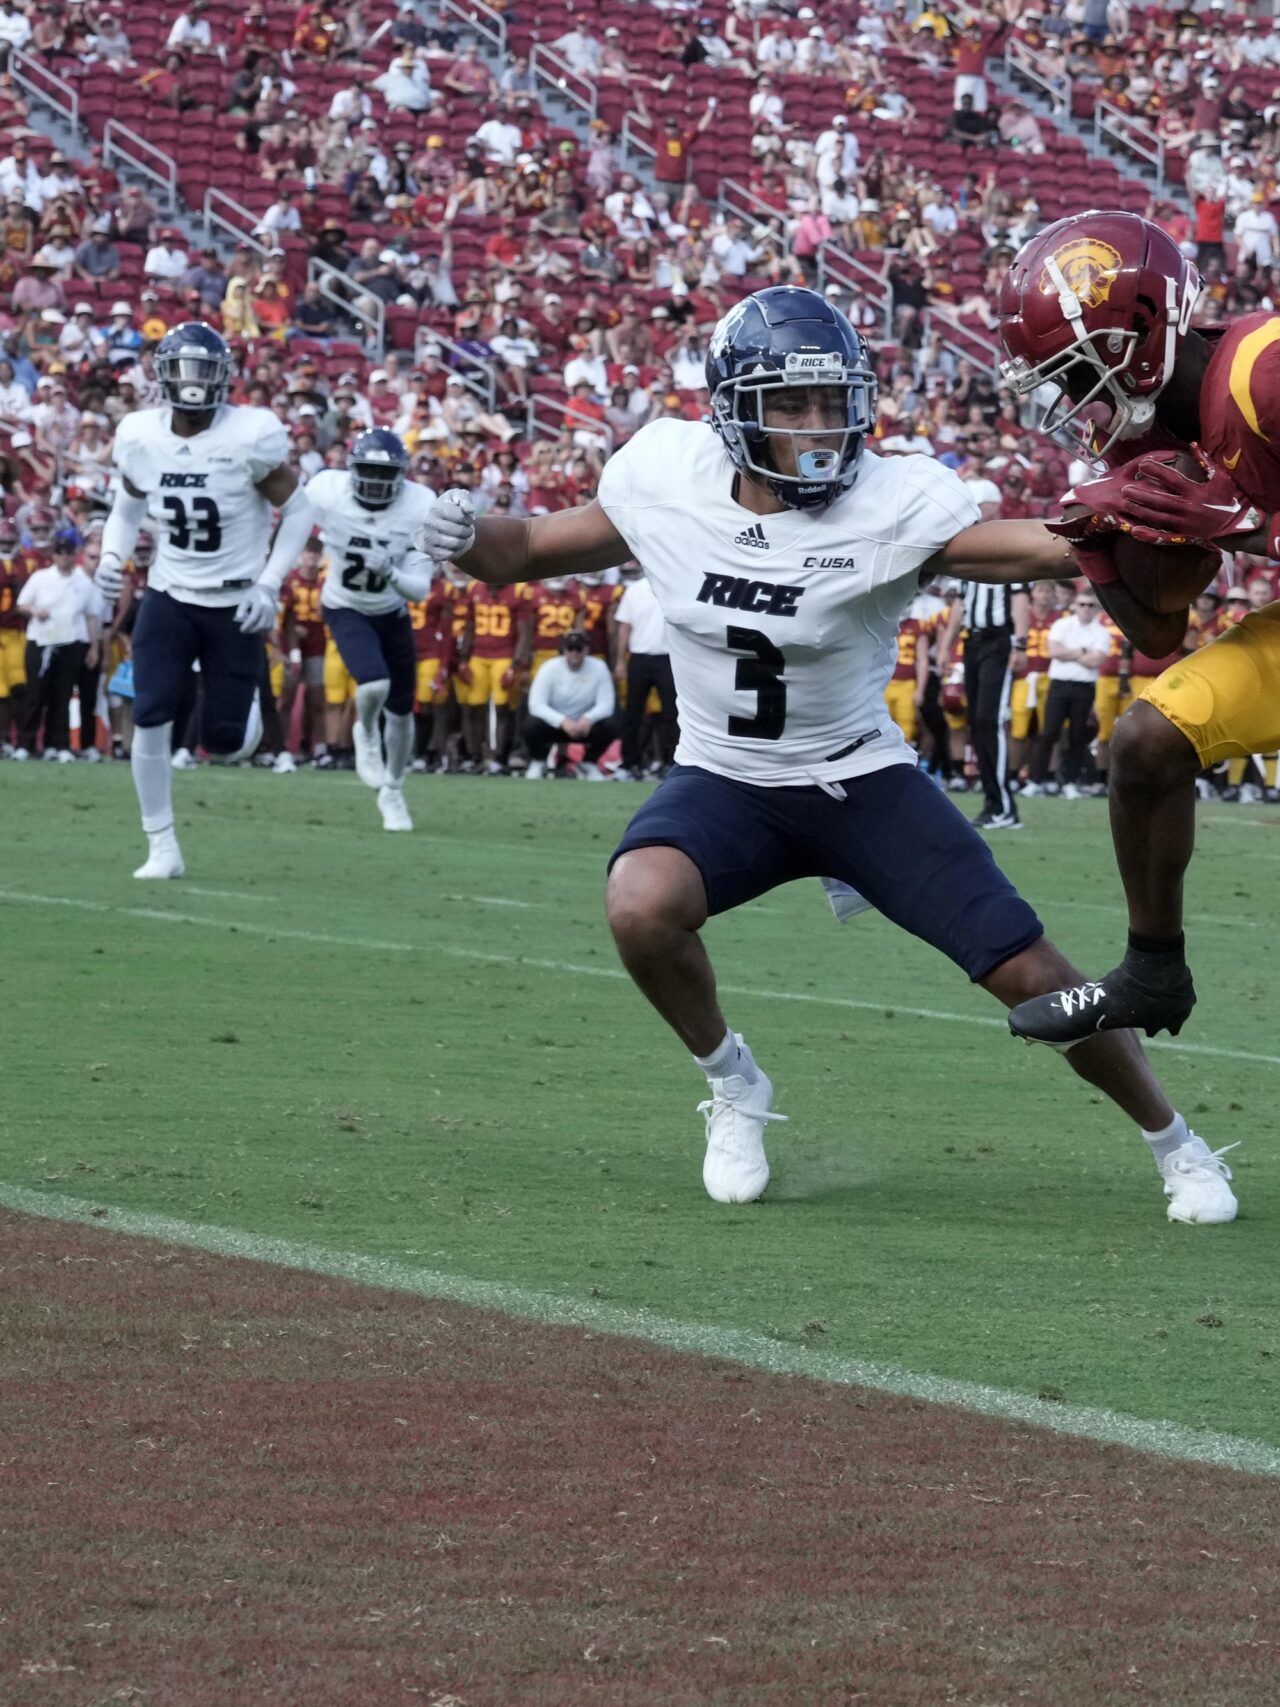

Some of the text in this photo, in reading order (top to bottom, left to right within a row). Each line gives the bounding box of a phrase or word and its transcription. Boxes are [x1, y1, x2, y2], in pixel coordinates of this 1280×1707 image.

[800, 358, 826, 367] RICE
[160, 473, 209, 488] RICE
[797, 484, 827, 495] Riddell
[163, 496, 222, 552] 33
[734, 535, 770, 550] adidas
[696, 571, 806, 617] RICE
[727, 625, 787, 740] 3
